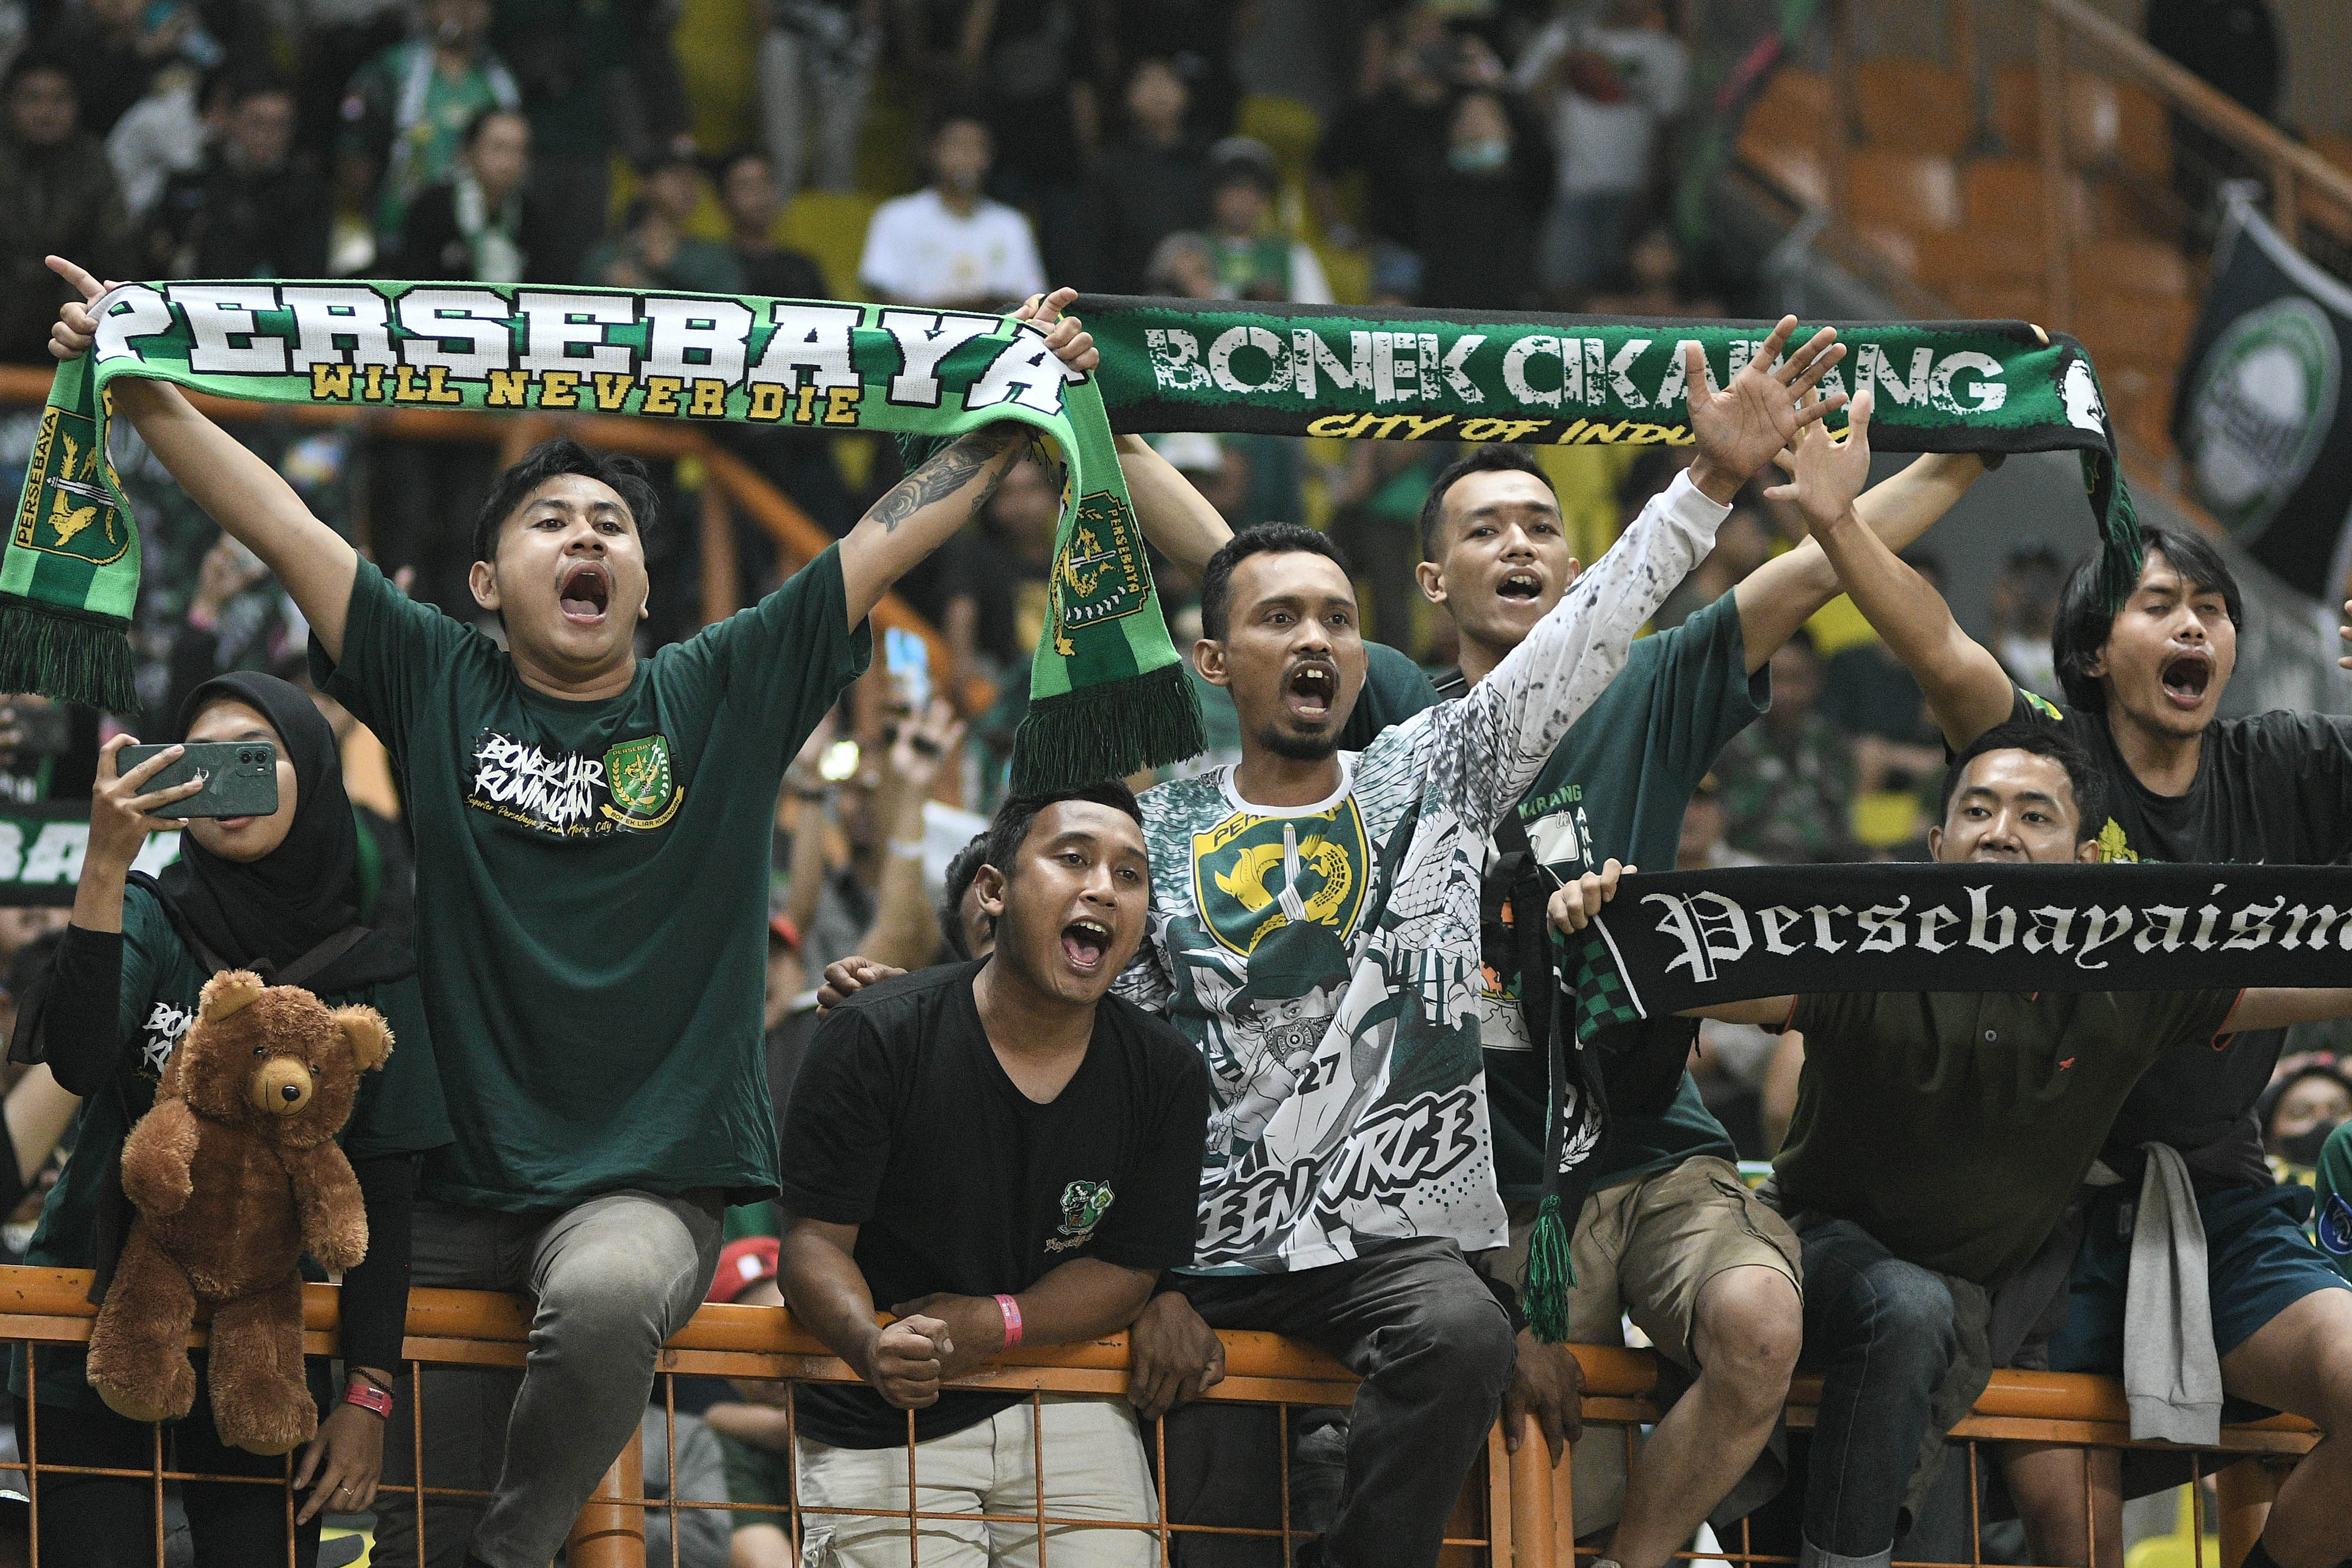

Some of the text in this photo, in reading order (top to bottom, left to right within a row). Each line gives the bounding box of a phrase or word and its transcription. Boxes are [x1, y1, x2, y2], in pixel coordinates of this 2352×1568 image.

[93, 281, 1090, 416] PERSEBAYA
[1145, 326, 1487, 404] BONEK
[310, 362, 861, 427] WILL NEVER DIE
[1307, 412, 1456, 442] CITY
[1457, 417, 1552, 443] OF
[16, 412, 57, 544] PERSEBAYA
[1107, 508, 1140, 594] PERSEBAYA
[474, 763, 593, 825] KUNINGAN
[1297, 1051, 1341, 1096] 27
